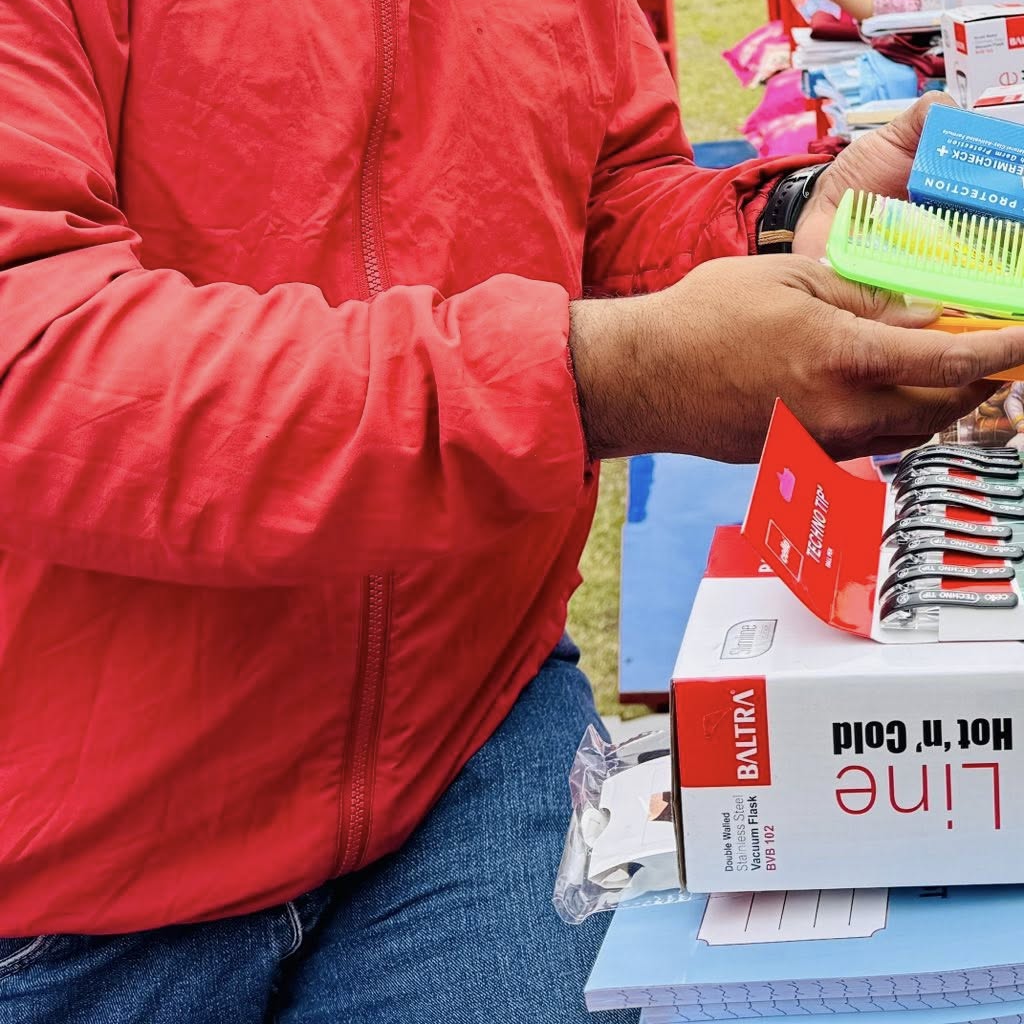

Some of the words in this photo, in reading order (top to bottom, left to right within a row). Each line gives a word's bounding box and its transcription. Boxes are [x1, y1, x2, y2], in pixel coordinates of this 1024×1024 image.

[947, 139, 992, 156] Protection
[995, 151, 1017, 163] Germ
[924, 178, 1018, 209] PROTECTION
[806, 509, 827, 563] TECHNO
[985, 593, 1009, 601] cello
[732, 688, 759, 780] BALTRA
[832, 720, 907, 755] Cold
[957, 718, 1013, 751] Hot
[732, 795, 745, 822] Steel
[747, 795, 759, 825] Flask
[835, 762, 1001, 830] Line
[722, 812, 731, 840] Walled
[764, 825, 775, 846] 102
[724, 842, 734, 872] Double
[735, 824, 748, 872] Stainless
[749, 828, 761, 871] Vacuum
[766, 847, 777, 871] BVB
